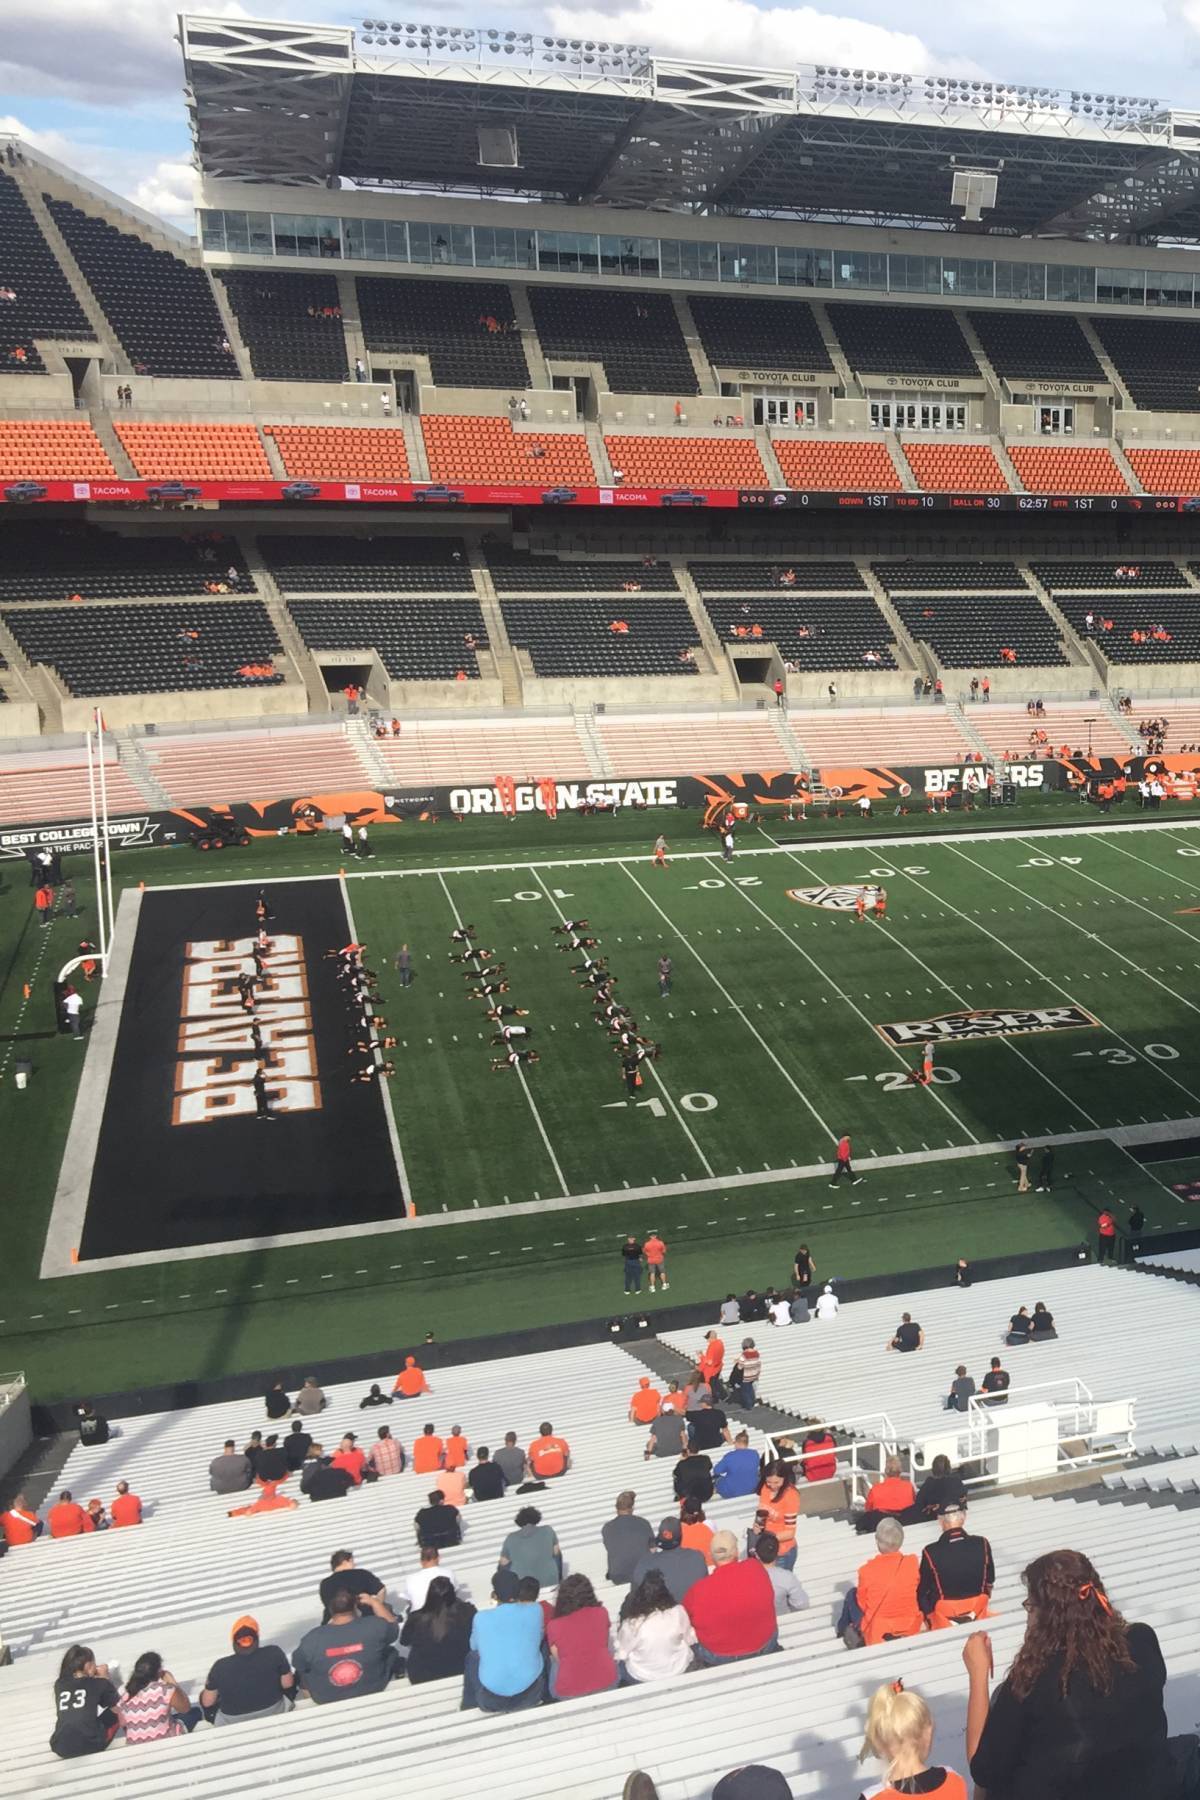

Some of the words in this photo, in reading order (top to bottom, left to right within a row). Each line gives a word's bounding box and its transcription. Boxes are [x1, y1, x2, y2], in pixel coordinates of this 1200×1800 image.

[752, 372, 789, 381] TOYOTA
[791, 374, 816, 382] CLUB
[901, 378, 934, 387] TOYOTA
[937, 379, 960, 388] CLUB
[1038, 383, 1071, 392] TOYOTA
[1073, 384, 1095, 393] CLUB
[93, 487, 131, 496] TACOMA
[363, 488, 398, 497] TACOMA
[615, 493, 648, 502] TACOMA
[866, 496, 888, 507] 1ST
[921, 496, 934, 507] 10
[987, 497, 1000, 508] 30
[1019, 498, 1048, 509] 62:57
[1074, 499, 1094, 509] 1ST
[924, 764, 1044, 793] BEAVRS
[586, 780, 678, 811] STATE
[1, 833, 37, 846] BEST
[39, 827, 98, 841] COLLEGE
[54, 845, 73, 853] THE
[73, 841, 104, 850] PAC-2
[171, 933, 323, 1126] BEAVERS
[892, 1009, 1083, 1040] RESER
[937, 1024, 1056, 1041] STADIUM
[1098, 1043, 1180, 1065] 30
[874, 1066, 961, 1092] 20
[636, 1092, 719, 1118] 10
[58, 1688, 88, 1711] 23
